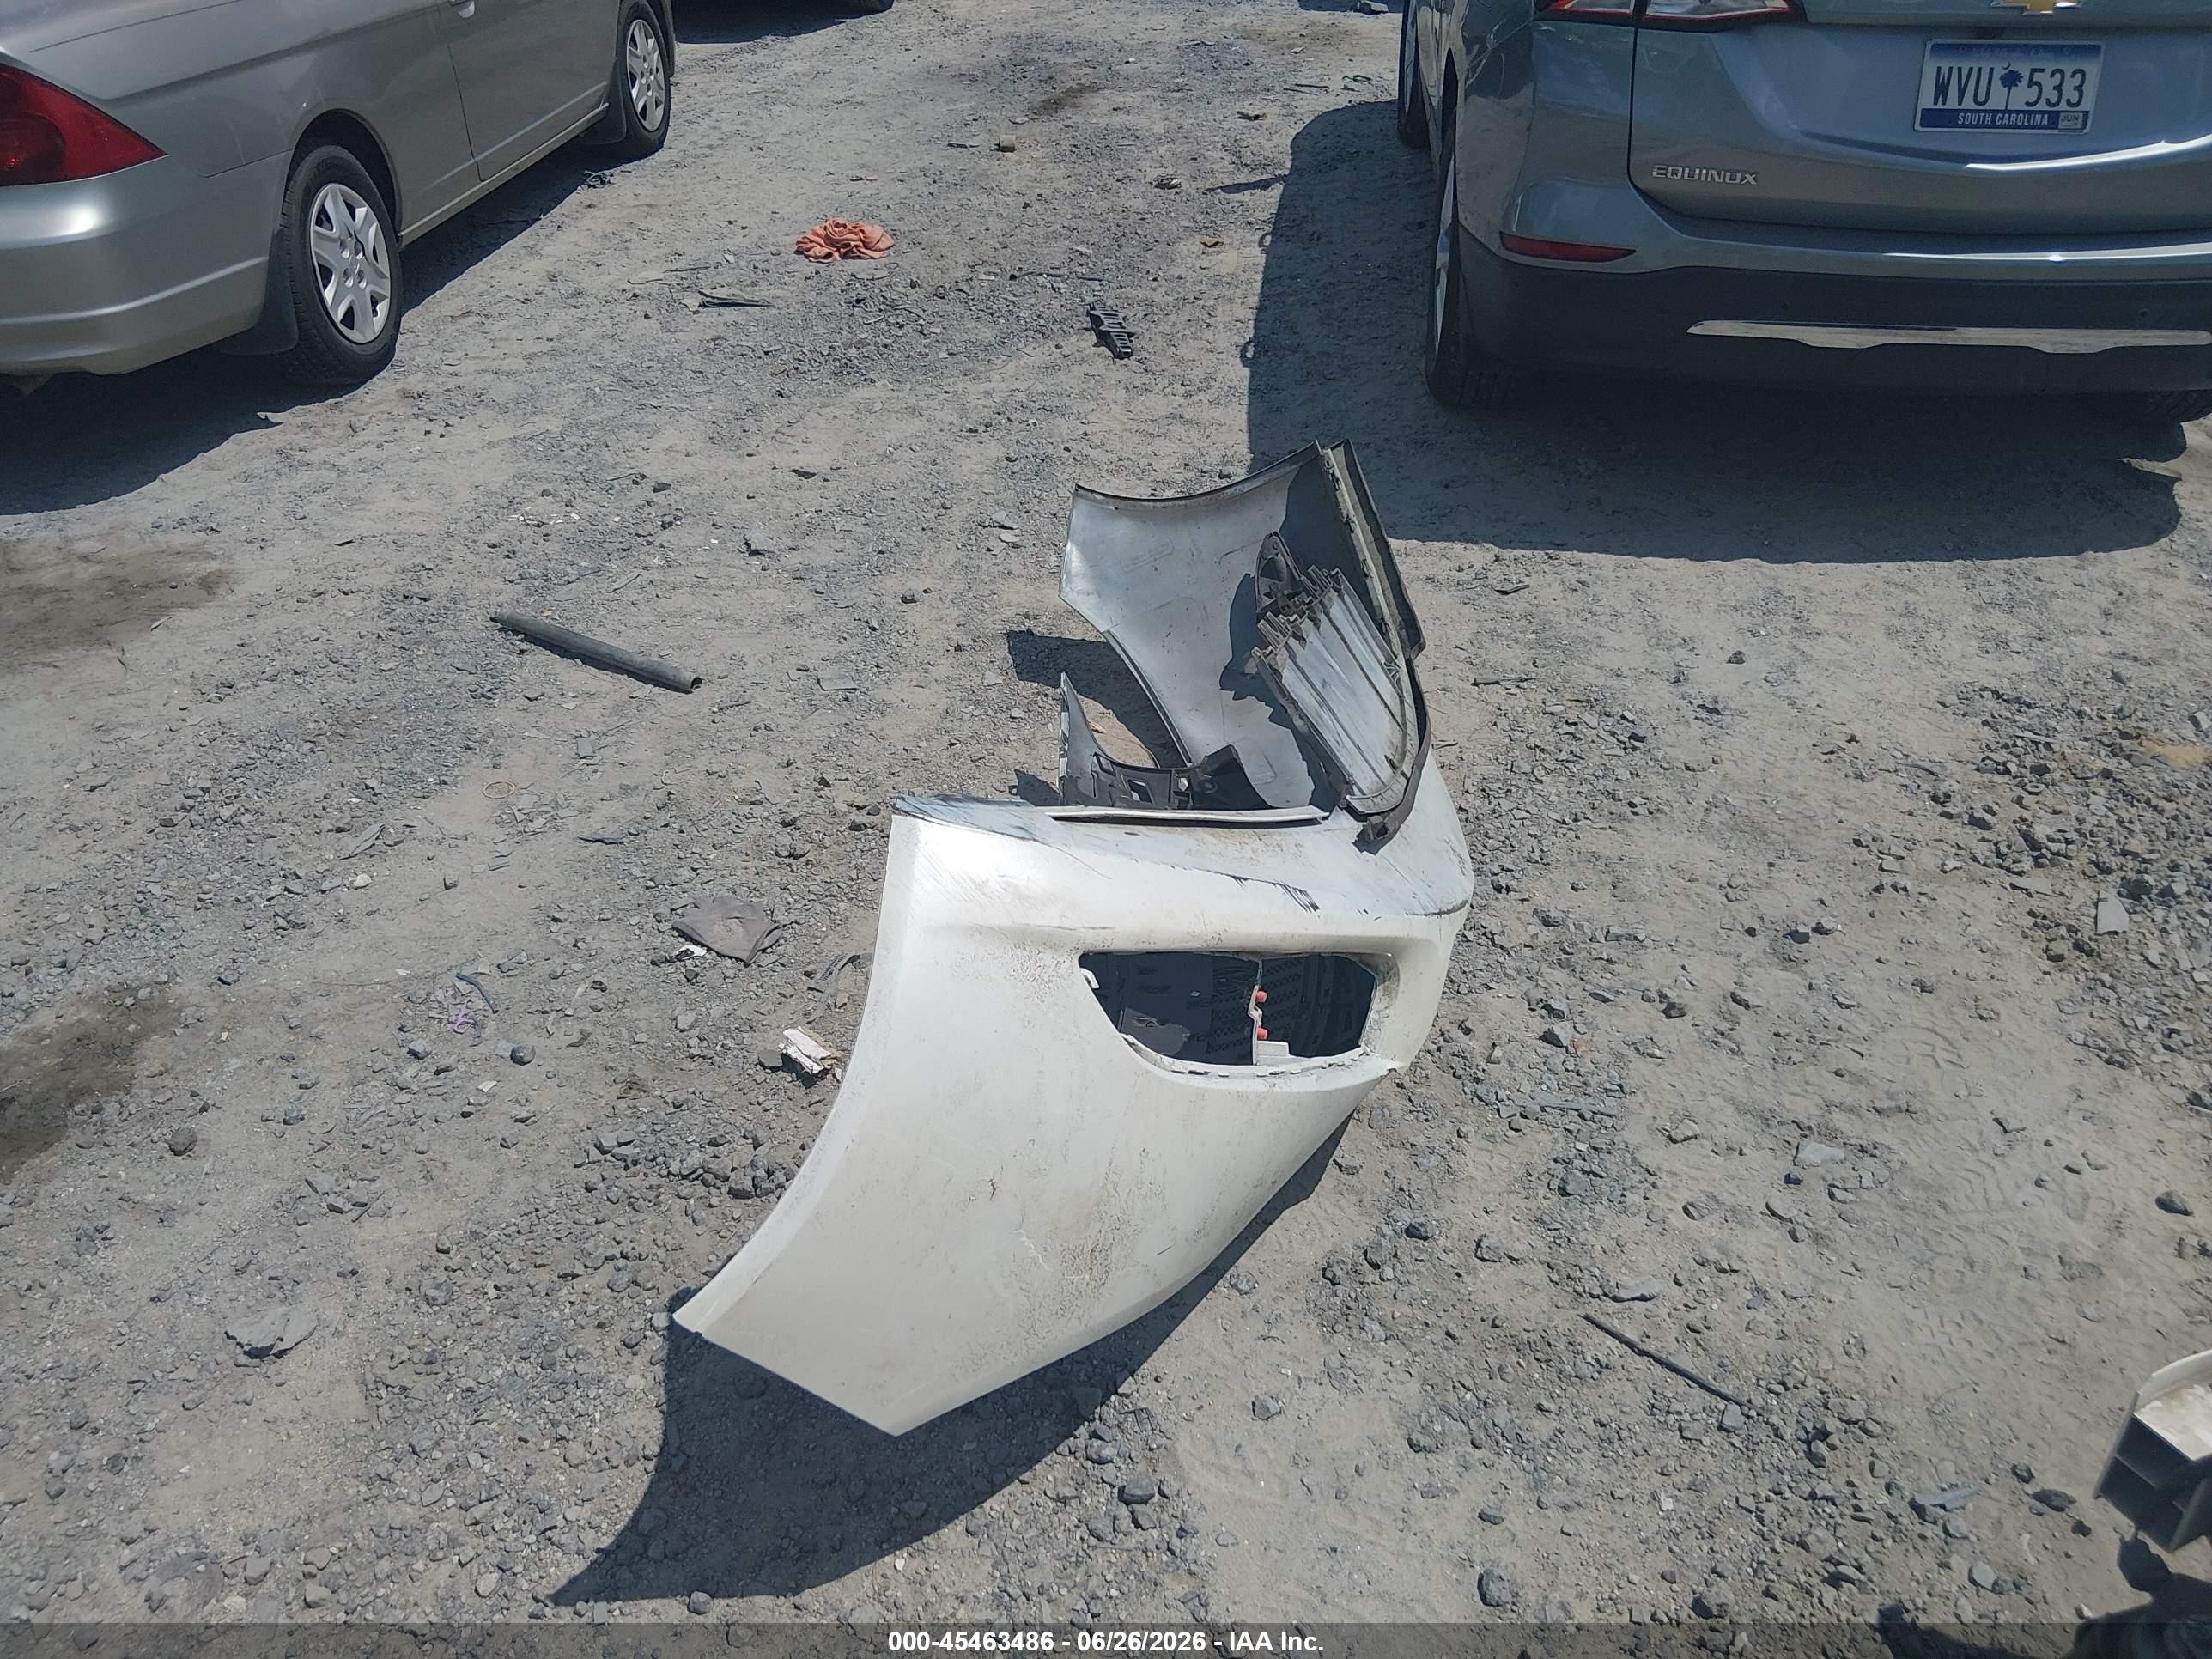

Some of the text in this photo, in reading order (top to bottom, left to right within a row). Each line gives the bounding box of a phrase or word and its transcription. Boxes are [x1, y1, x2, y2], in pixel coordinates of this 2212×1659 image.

[1932, 65, 2087, 108] WVU 533
[1957, 112, 2049, 126] SOUTH CAROLINA
[2061, 114, 2080, 123] JUN
[1652, 164, 1759, 185] EQUINOX
